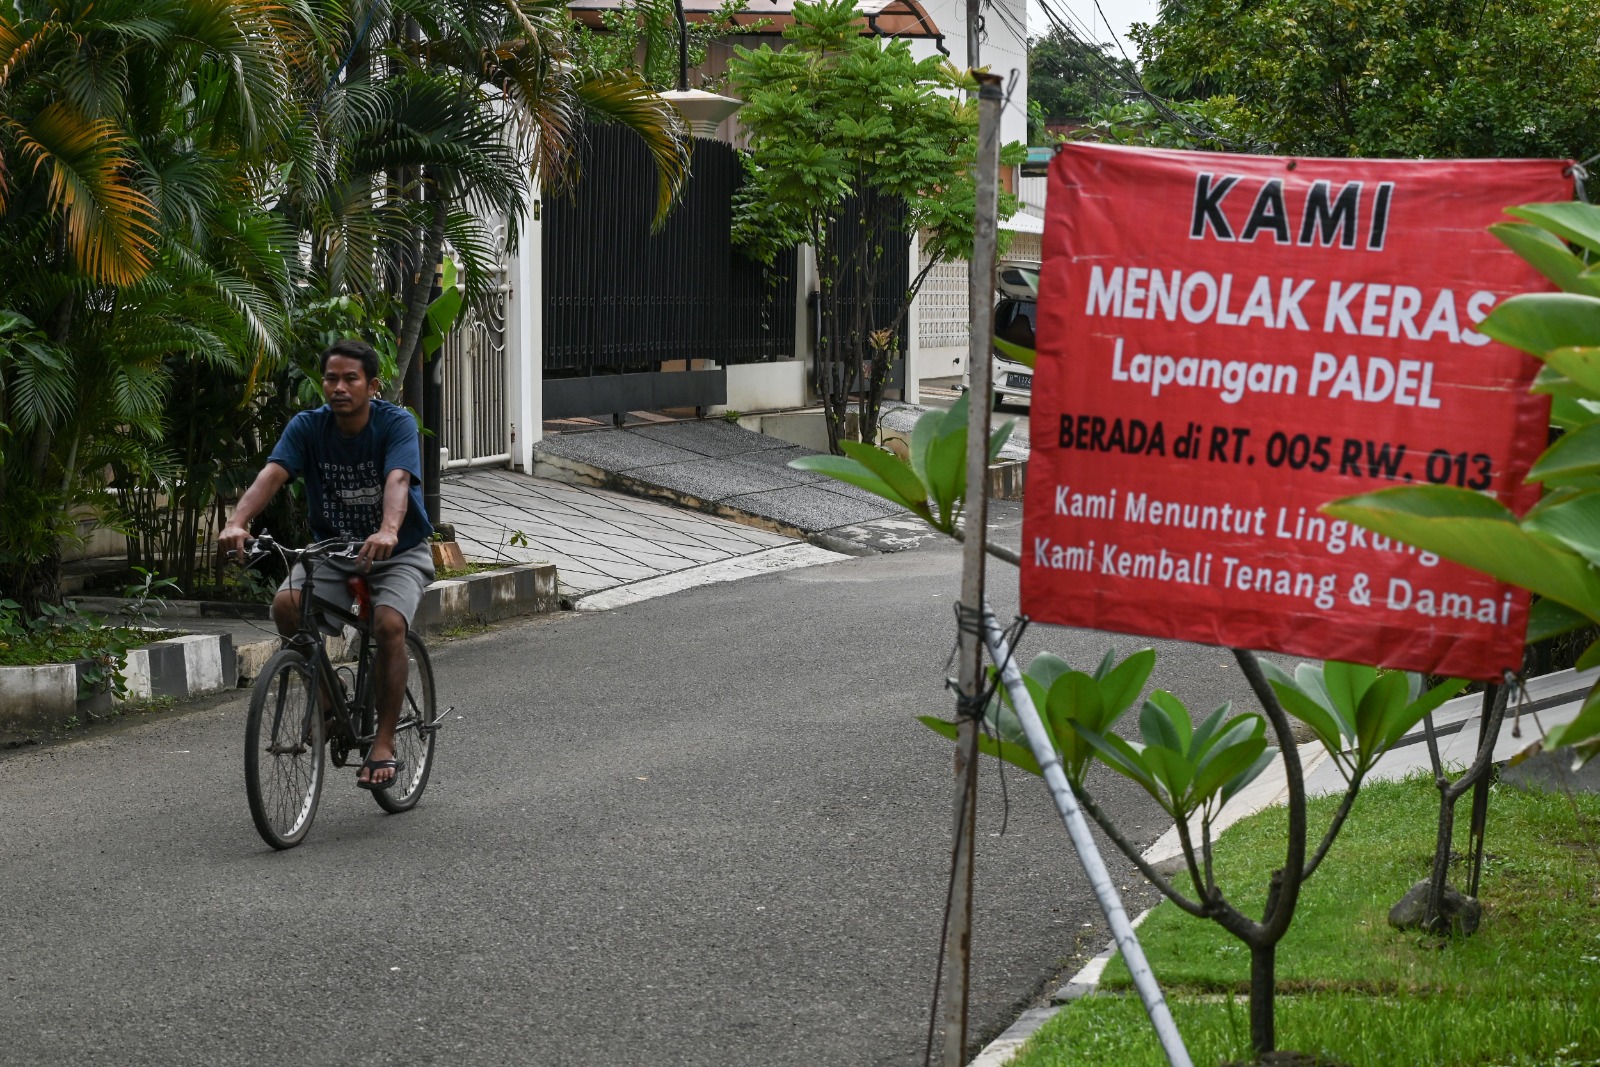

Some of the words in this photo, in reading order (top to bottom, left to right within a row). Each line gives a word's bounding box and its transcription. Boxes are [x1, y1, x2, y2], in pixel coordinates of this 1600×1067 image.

[1189, 171, 1396, 253] KAMI
[1085, 264, 1317, 333] MENOLAK
[1322, 280, 1498, 349] KERAS
[1110, 336, 1299, 405] Lapangan
[1306, 350, 1443, 410] PADEL
[1058, 413, 1166, 456] BERADA
[1173, 423, 1203, 459] di
[1208, 426, 1256, 464] RT.
[1266, 432, 1332, 474] 005
[1340, 439, 1414, 485] RW.
[1426, 449, 1494, 493] 013
[1054, 484, 1117, 522] Kami
[1124, 491, 1268, 538] Menuntut
[1034, 537, 1095, 573] Kami
[1101, 544, 1213, 587] Kembali
[1221, 555, 1338, 611] Tenang
[1347, 572, 1372, 608] &
[1386, 577, 1513, 625] Damai
